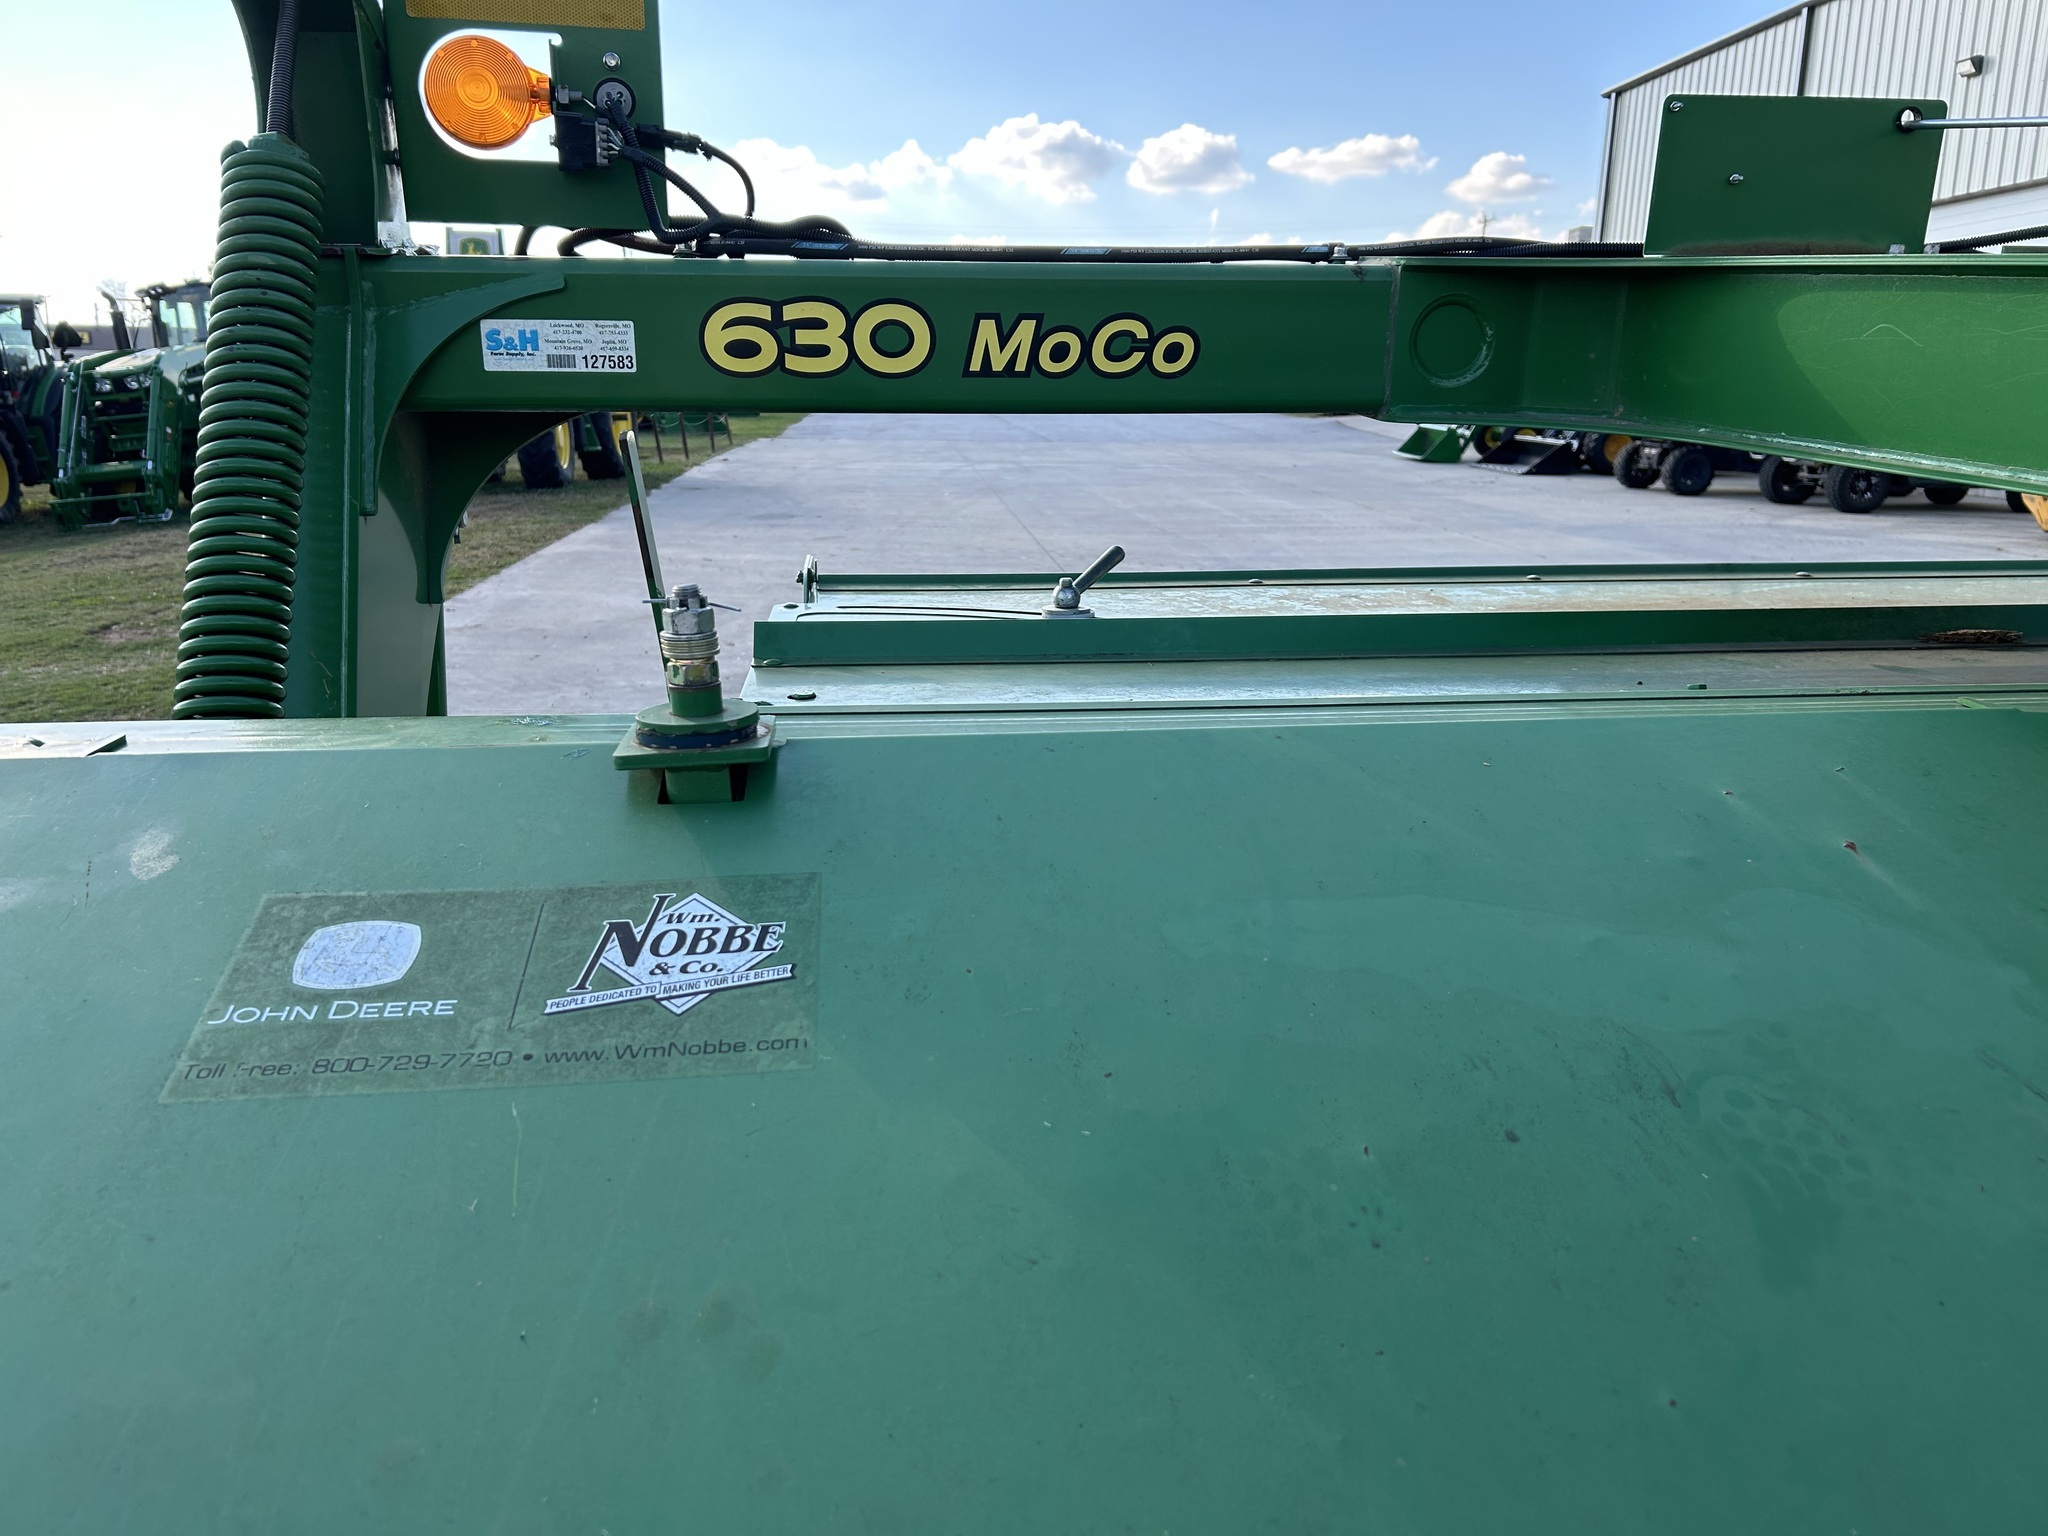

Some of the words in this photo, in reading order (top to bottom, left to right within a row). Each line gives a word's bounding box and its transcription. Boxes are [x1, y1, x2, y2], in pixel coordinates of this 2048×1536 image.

[485, 328, 540, 351] S&H
[702, 298, 934, 377] 630
[964, 314, 1198, 376] MoCo
[581, 355, 634, 369] 127583
[665, 912, 721, 924] Wm.
[567, 893, 786, 992] NOBBE
[649, 962, 675, 976] &
[679, 960, 724, 974] Co.
[550, 997, 587, 1010] PEOPLE
[589, 988, 642, 1004] DEDICATED
[643, 985, 658, 997] TO
[663, 981, 701, 995] MAKING
[704, 975, 729, 988] YOUR
[731, 972, 752, 984] LIFE
[753, 966, 789, 980] BETTER
[207, 1004, 319, 1025] JOHN
[327, 1000, 458, 1020] DEERE
[184, 1063, 226, 1080] Toll
[311, 1050, 512, 1075] 800-729-7720
[544, 1037, 809, 1064] www.WmNobbe.com
